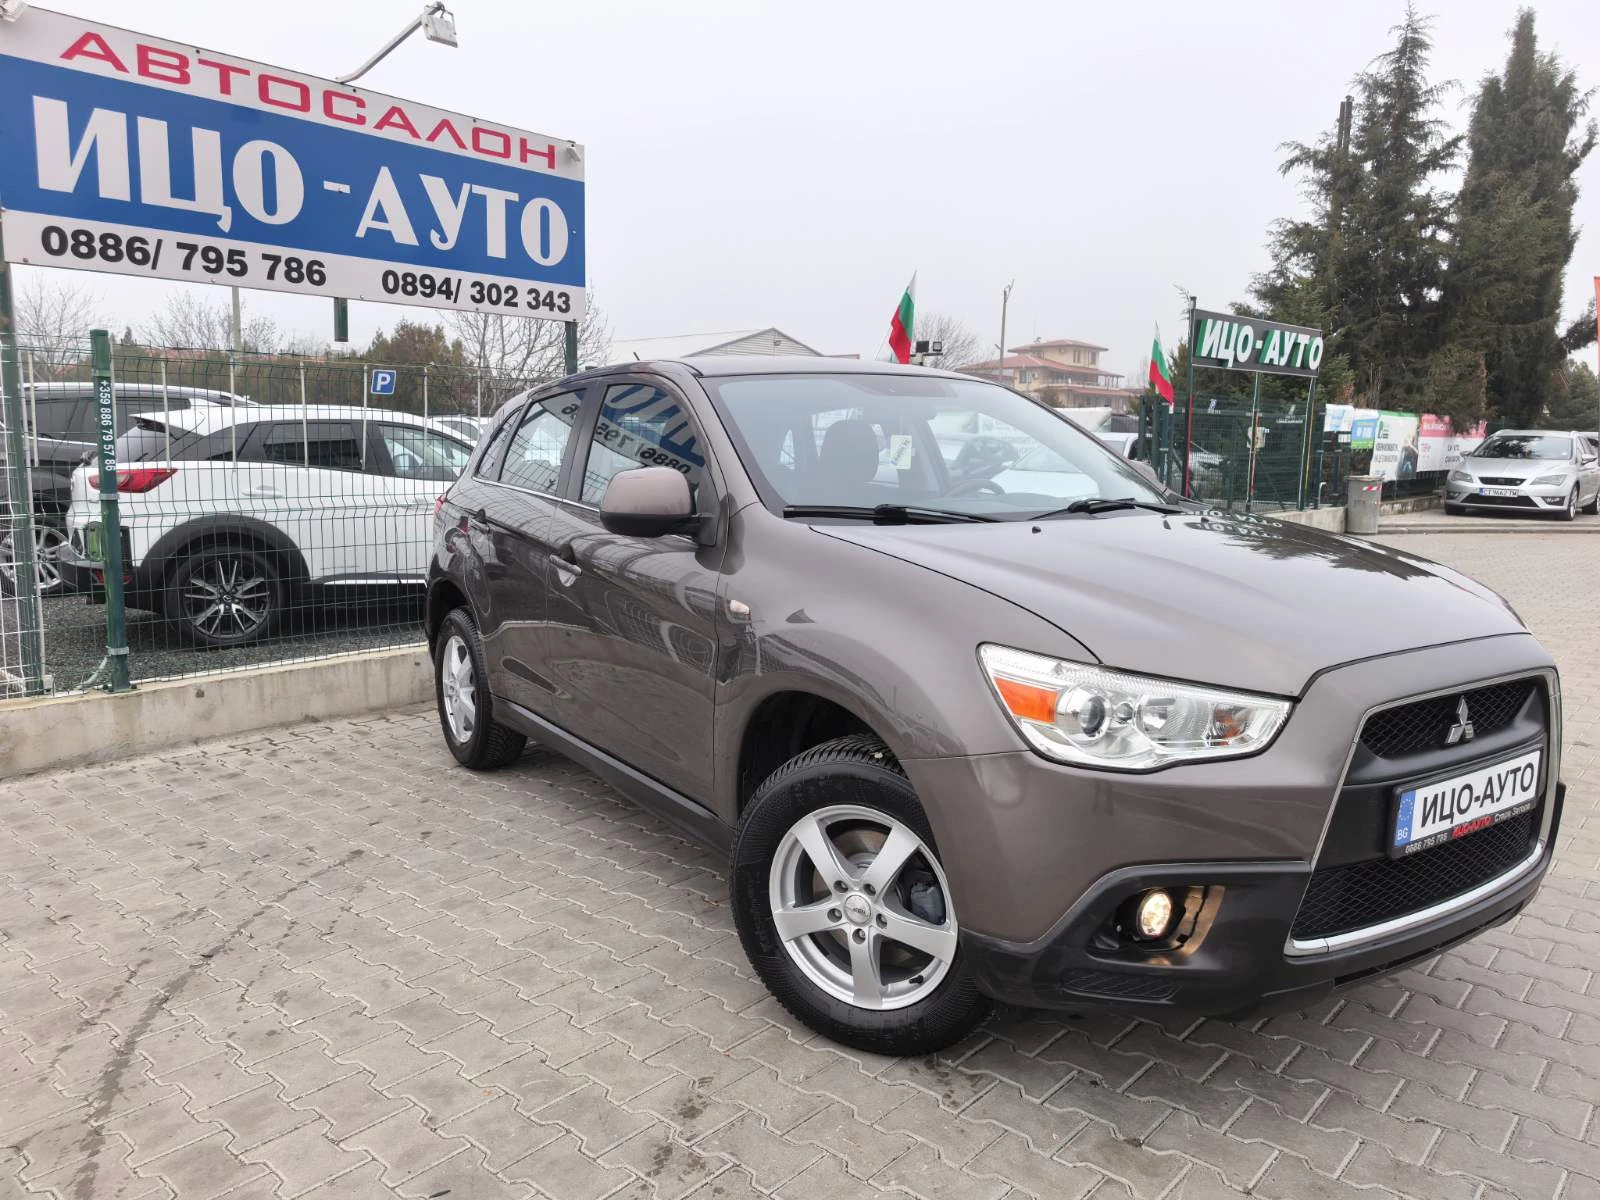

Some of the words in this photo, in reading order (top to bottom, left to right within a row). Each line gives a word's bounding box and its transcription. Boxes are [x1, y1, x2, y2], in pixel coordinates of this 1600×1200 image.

[60, 32, 555, 170] АВТОСАЛОН
[32, 95, 304, 233] ИЦО
[41, 225, 163, 270] 0886/
[176, 242, 249, 277] 795
[261, 253, 327, 287] 786
[382, 269, 462, 304] 0894/
[470, 280, 519, 308] 302
[526, 287, 571, 314] 343
[99, 380, 111, 405] +359
[376, 373, 391, 391] P
[100, 407, 112, 426] 886
[102, 429, 114, 441] 79
[103, 444, 116, 457] 57
[104, 459, 117, 471] 86
[1420, 762, 1535, 829] ИЦО-АУТО
[1397, 827, 1409, 840] BG
